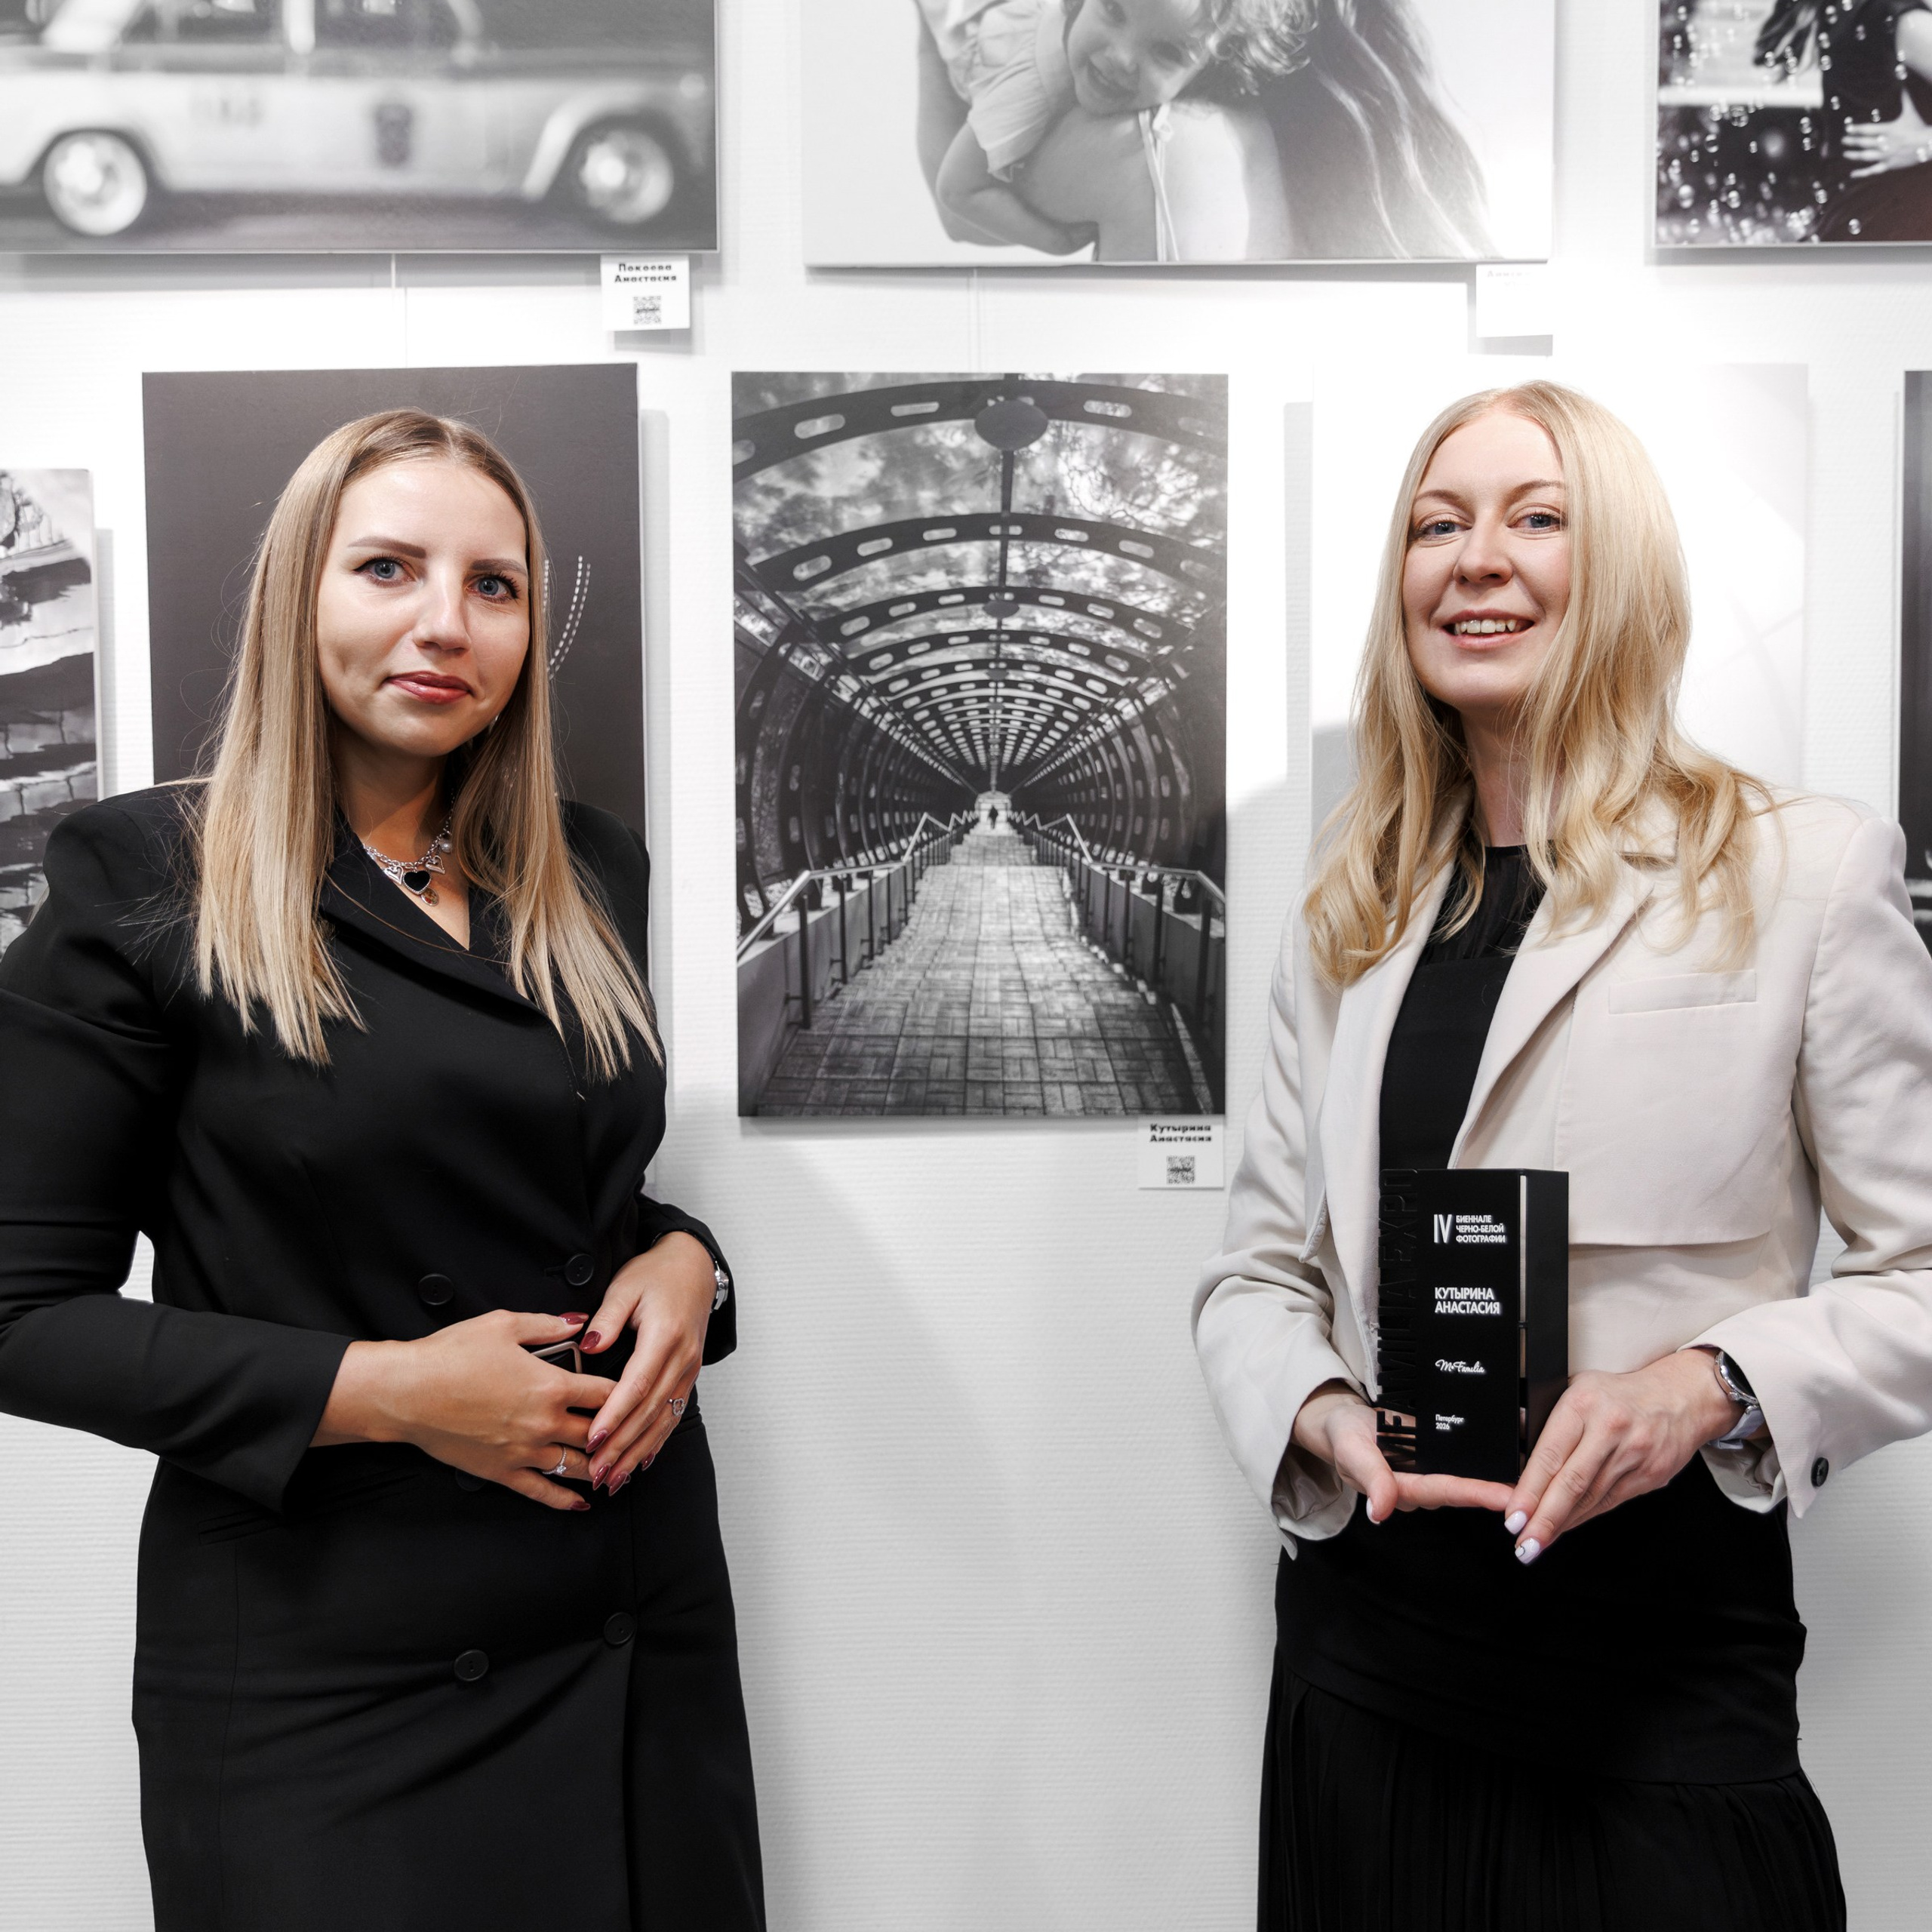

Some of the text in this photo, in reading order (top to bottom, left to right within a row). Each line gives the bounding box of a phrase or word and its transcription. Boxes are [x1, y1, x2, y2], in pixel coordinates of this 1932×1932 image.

[1149, 1123, 1211, 1134] Кутырина
[1149, 1134, 1212, 1143] Анастасия
[1456, 1214, 1492, 1223] БИЕННАЛЕ
[1433, 1214, 1453, 1244] IV
[1456, 1223, 1505, 1233] ЧЕРНО-БЕЛОЙ
[1455, 1234, 1506, 1244] ФОТОГРАФИИ
[1434, 1287, 1495, 1300] КУТЫРИНА
[1434, 1300, 1500, 1315] АНАСТАСИЯ
[1435, 1414, 1464, 1424] Петербург
